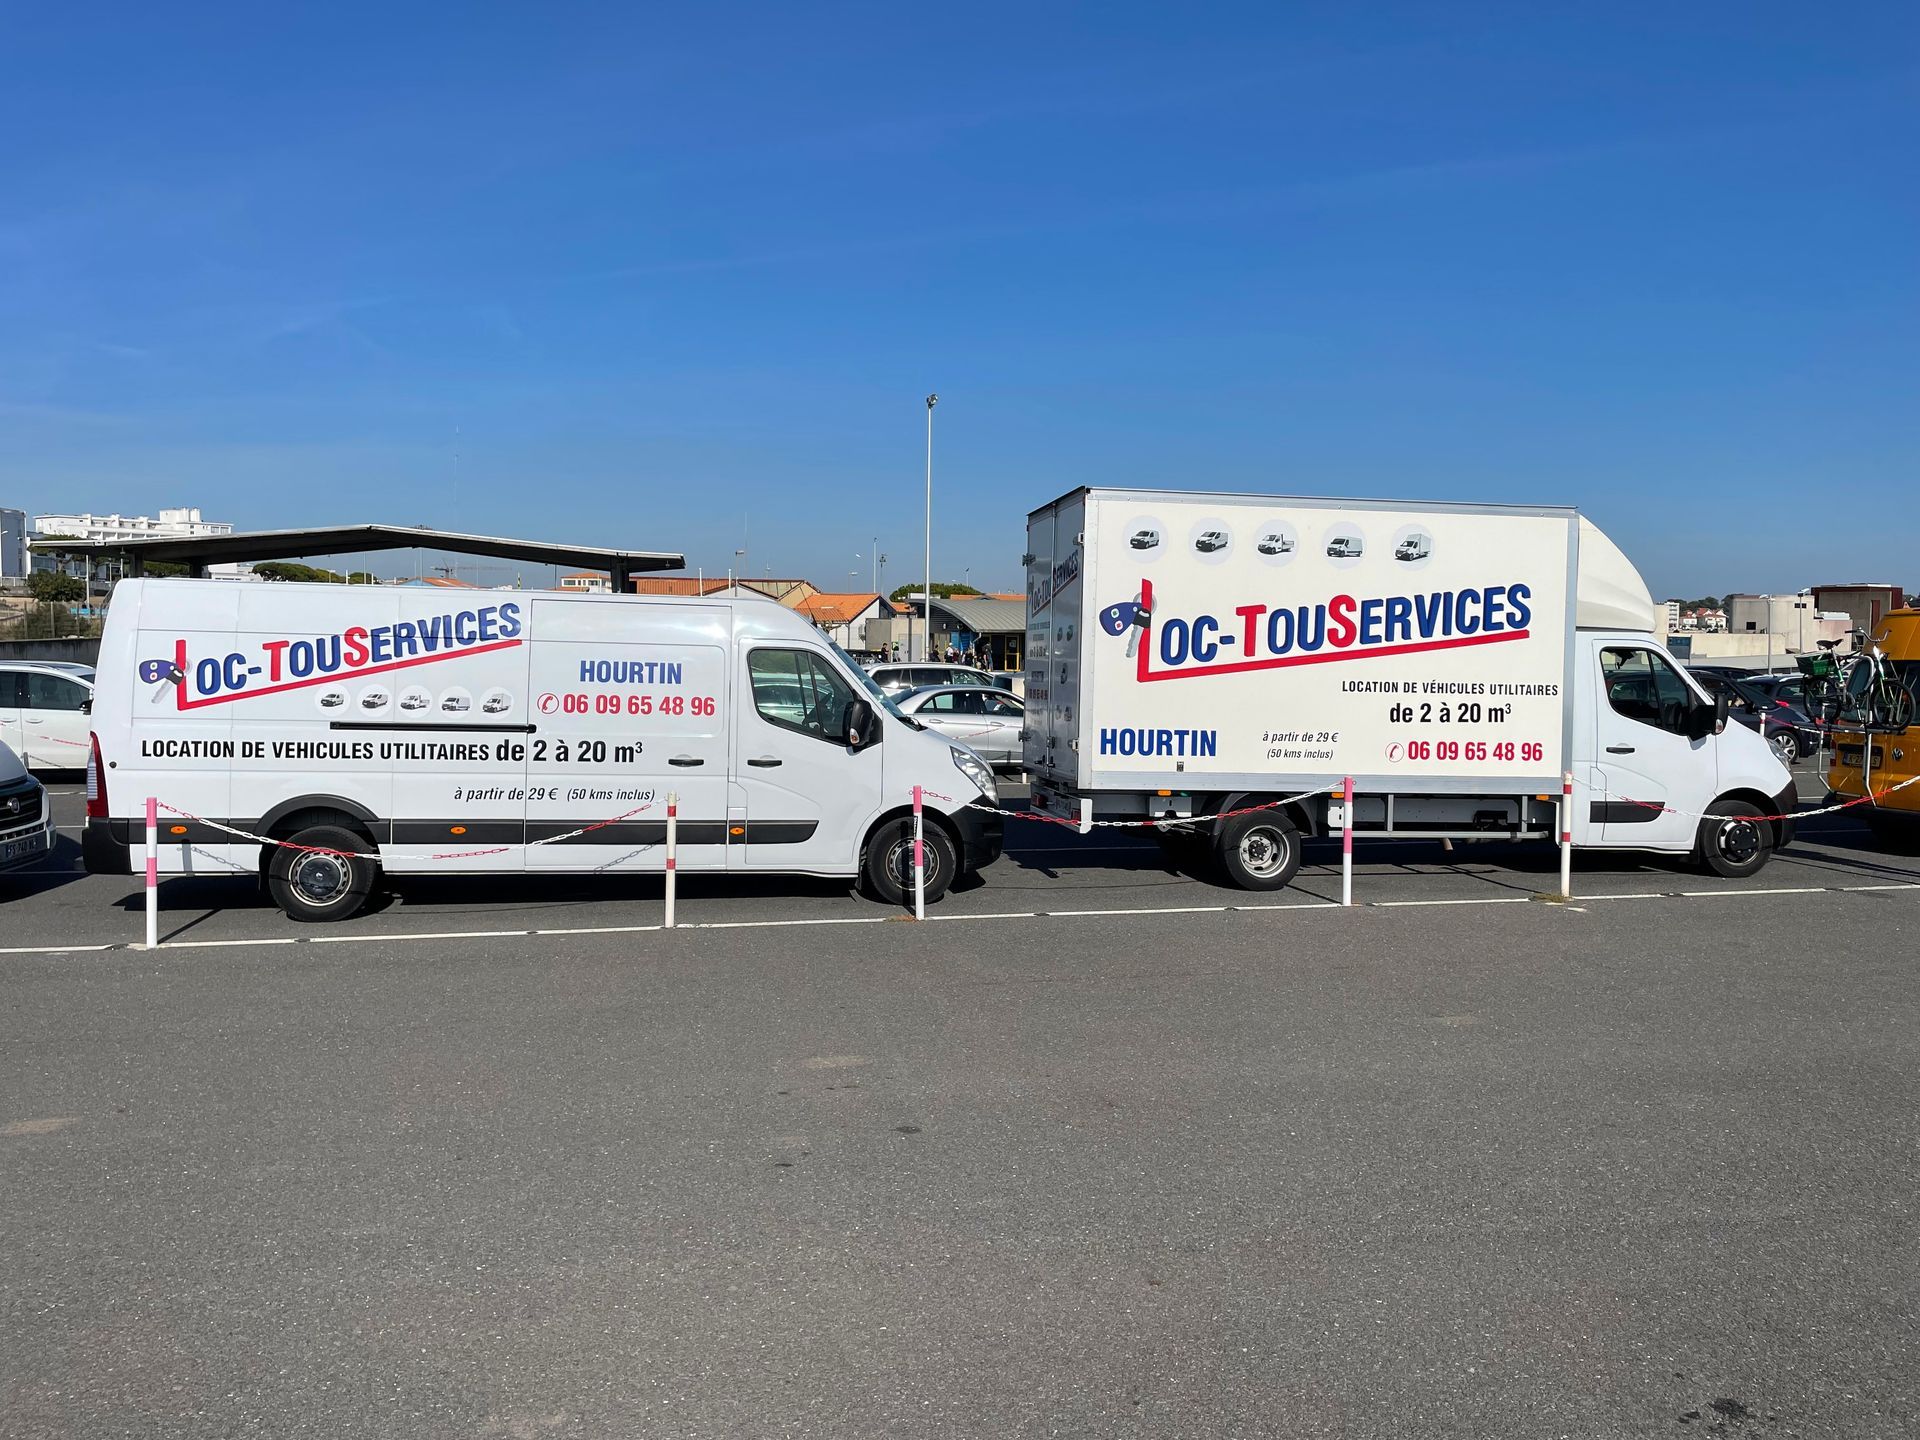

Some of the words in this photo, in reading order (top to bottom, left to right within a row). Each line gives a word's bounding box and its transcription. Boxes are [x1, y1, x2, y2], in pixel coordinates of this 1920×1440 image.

[579, 660, 682, 685] HOURTIN
[1342, 680, 1399, 693] LOCATION
[1403, 682, 1418, 693] DE
[1422, 679, 1485, 695] VÉHICULES
[1489, 683, 1558, 696] UTILITAIRES
[562, 693, 589, 715] 06
[595, 694, 621, 715] 09
[627, 695, 653, 716] 65
[659, 695, 685, 716] 48
[690, 696, 716, 717] 96
[1389, 702, 1413, 724] de
[1419, 702, 1432, 723] 2
[1439, 702, 1451, 723] à
[1457, 702, 1481, 724] 20
[1100, 727, 1218, 758] HOURTIN
[1262, 730, 1269, 742] à
[1271, 731, 1299, 744] partir
[1301, 731, 1314, 743] de
[1316, 731, 1329, 743] 29
[1331, 732, 1339, 743] €
[141, 739, 235, 759] LOCATION
[241, 741, 266, 759] DE
[271, 741, 374, 760] VEHICULES
[380, 742, 490, 761] UTILITAIRES
[496, 738, 527, 762] de
[532, 739, 547, 762] 2
[555, 738, 570, 763] à
[577, 740, 607, 763] 20
[1267, 748, 1282, 760] (50
[1283, 748, 1302, 759] kms
[1304, 748, 1334, 761] inclus)
[1407, 740, 1431, 761] 06
[1435, 740, 1459, 761] 09
[1464, 741, 1487, 761] 65
[1492, 741, 1515, 762] 48
[1520, 741, 1543, 762] 96
[454, 786, 463, 800] à
[465, 787, 505, 803] partir
[507, 787, 525, 801] de
[527, 787, 546, 801] 29
[548, 788, 559, 801] €
[566, 788, 587, 802] (50
[588, 788, 613, 802] kms
[616, 788, 656, 803] inclus)
